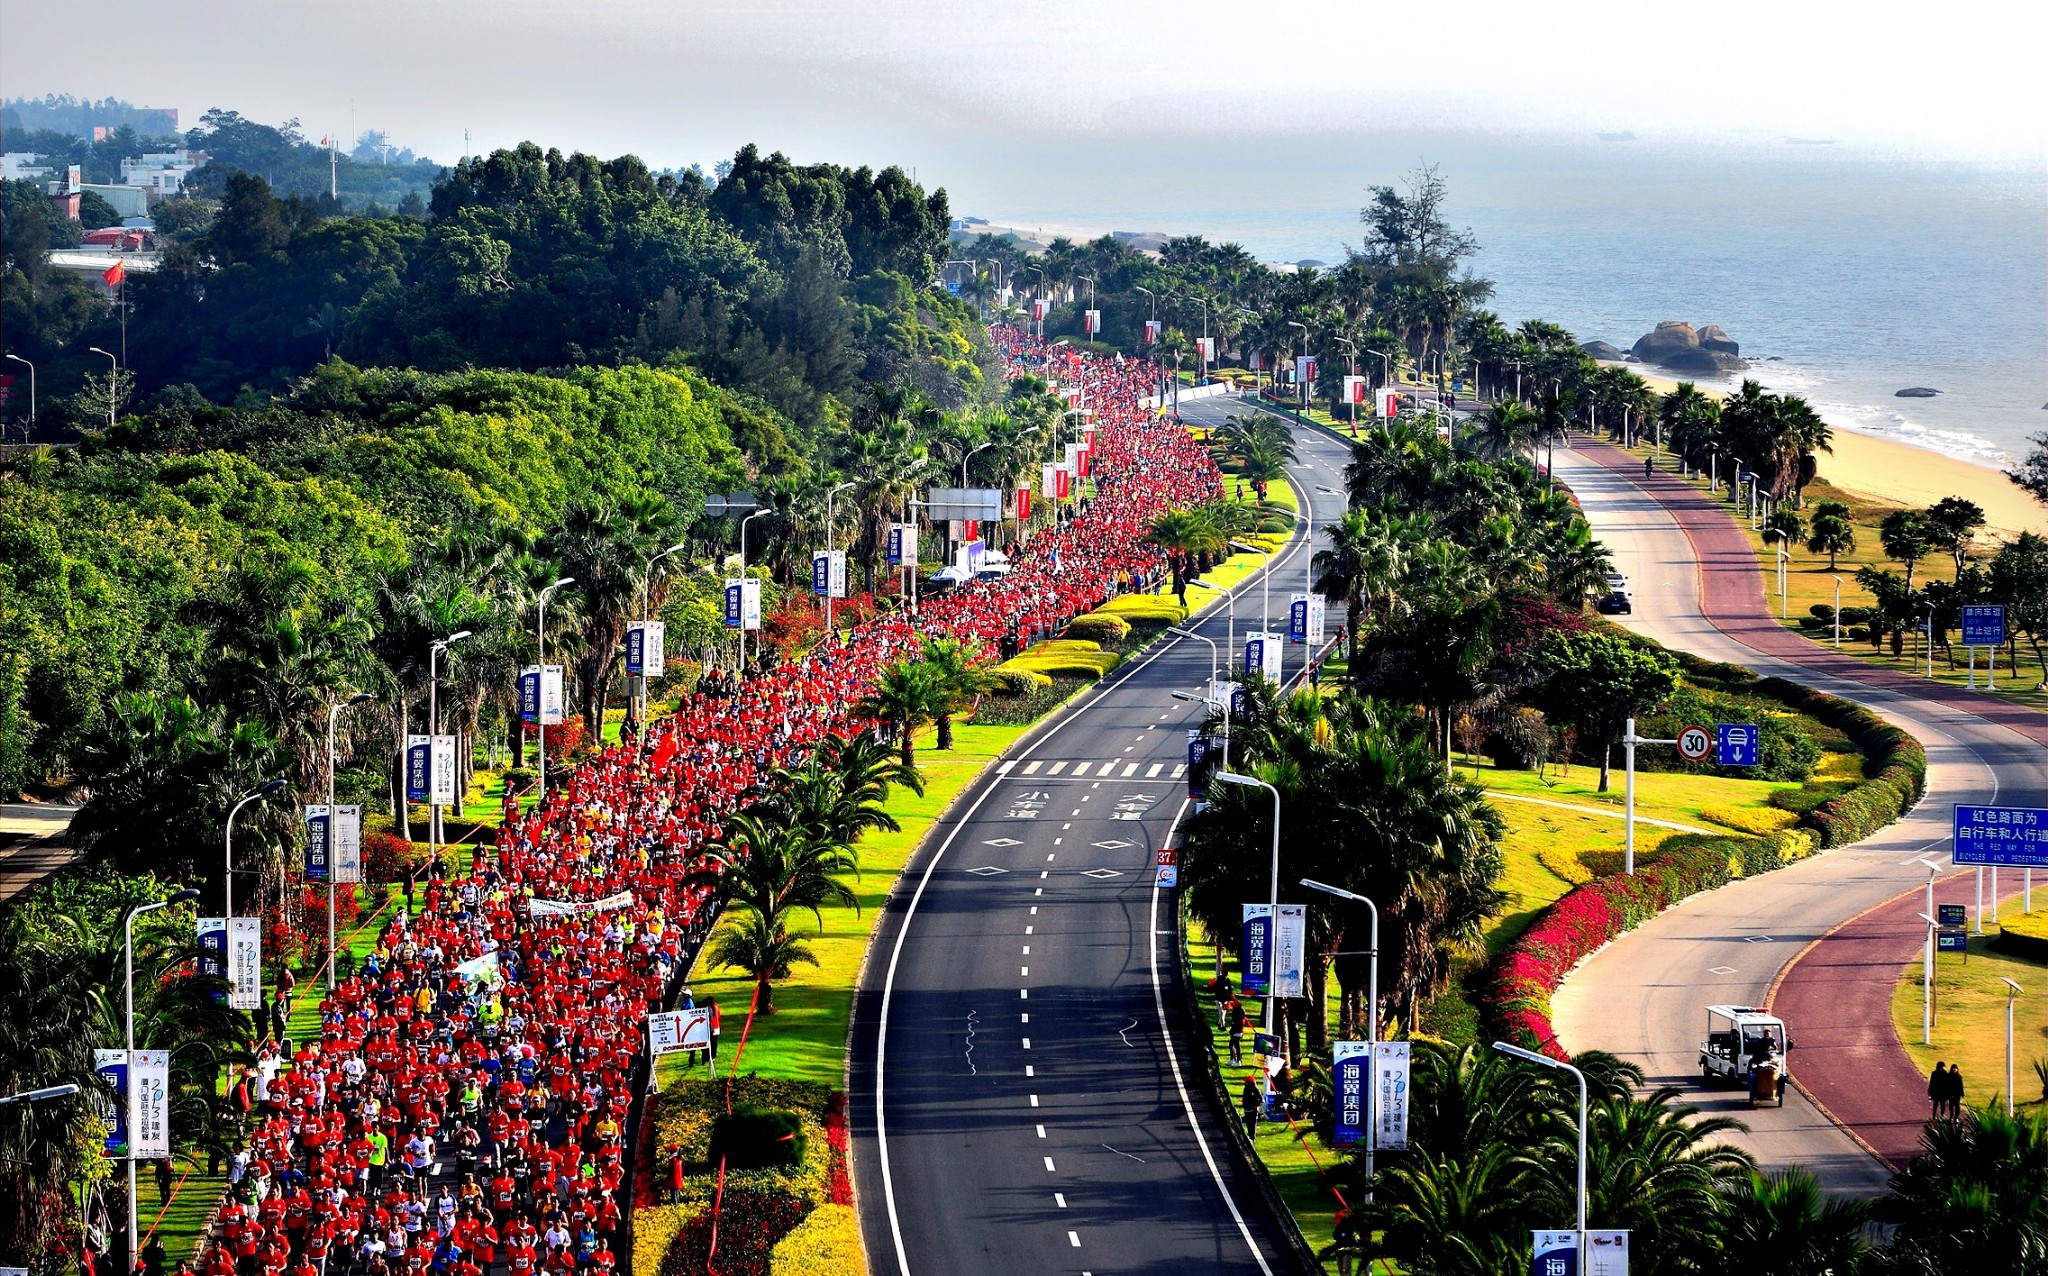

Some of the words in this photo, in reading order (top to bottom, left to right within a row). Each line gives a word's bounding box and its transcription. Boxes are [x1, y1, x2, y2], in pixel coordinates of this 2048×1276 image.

[1686, 735, 1705, 752] 30
[1972, 810, 2037, 825] 红色路面为
[1959, 826, 2048, 842] 自行车和人行道
[1973, 842, 1984, 850] THE
[1990, 843, 2001, 851] RED
[1158, 852, 1171, 863] 37
[1959, 853, 1986, 861] BICYCLES
[1250, 922, 1264, 974] 海翼集团
[1343, 1064, 1359, 1125] 海翼集团
[1393, 1071, 1406, 1132] 2013建发
[151, 1079, 163, 1141] 2013建发
[1546, 1259, 1566, 1276] 海
